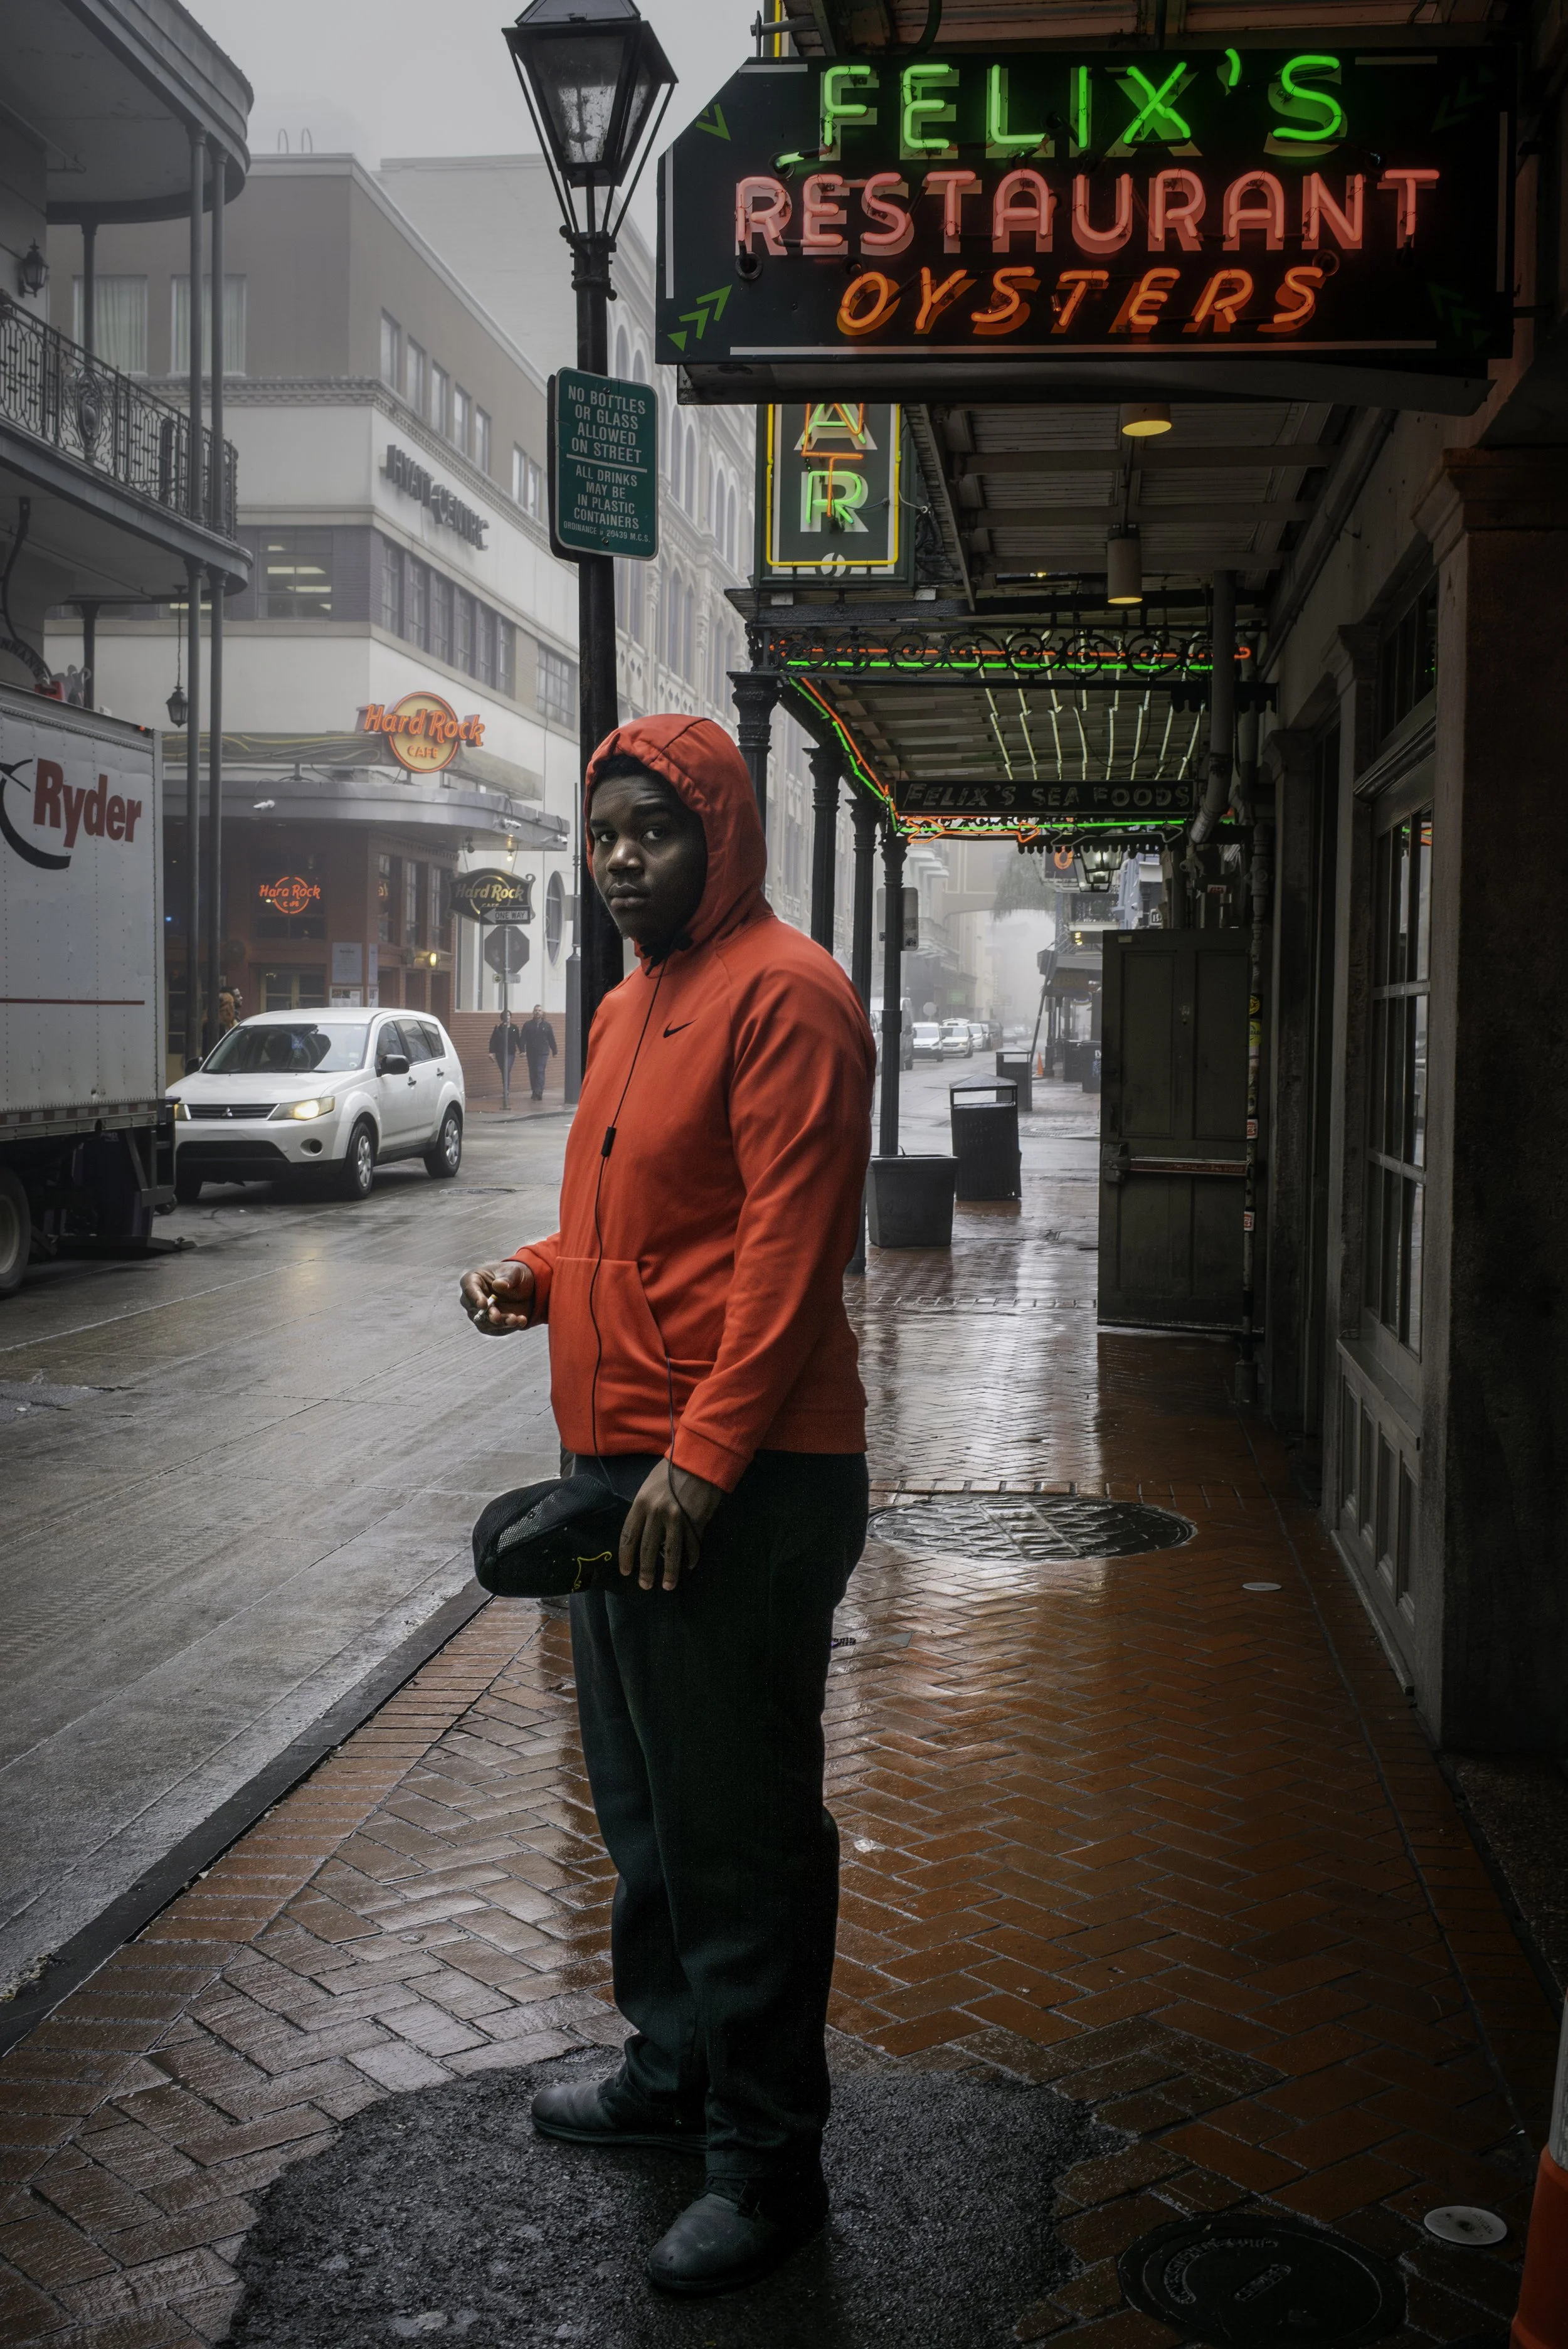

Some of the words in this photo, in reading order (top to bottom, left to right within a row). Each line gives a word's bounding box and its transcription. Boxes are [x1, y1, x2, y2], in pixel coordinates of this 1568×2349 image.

[820, 49, 1347, 160] FELIX'S
[735, 170, 1439, 256] RESTAURANT
[836, 267, 1325, 335] OYSTERS
[568, 385, 585, 401] NO
[590, 391, 645, 414] BOTTLES
[575, 405, 590, 420] OR
[596, 409, 638, 430] GLASS
[578, 422, 636, 445] ALLOWED
[572, 437, 587, 453] ON
[593, 442, 642, 463] STREET
[576, 465, 593, 479] ALL
[597, 469, 637, 487] DRINKS
[586, 481, 607, 496] MAY
[612, 486, 626, 499] BE
[578, 494, 588, 507] IN
[592, 497, 635, 514] PLASTIC
[574, 507, 639, 529] CONTAINERS
[564, 521, 597, 535] ORDINANCE
[607, 529, 627, 539] 20439
[630, 533, 651, 543] M.C.S.
[364, 703, 428, 734] Hard
[429, 710, 486, 746] Rock
[408, 745, 438, 759] CAFE
[33, 758, 142, 849] Ryder
[903, 783, 1017, 808] FELIX'S
[1032, 787, 1079, 806] SEA
[1093, 786, 1190, 808] FOODS
[292, 884, 320, 899] Rock
[455, 883, 490, 899] Hard
[491, 884, 524, 902] Rock
[495, 911, 510, 920] ONE
[511, 911, 526, 920] WAY
